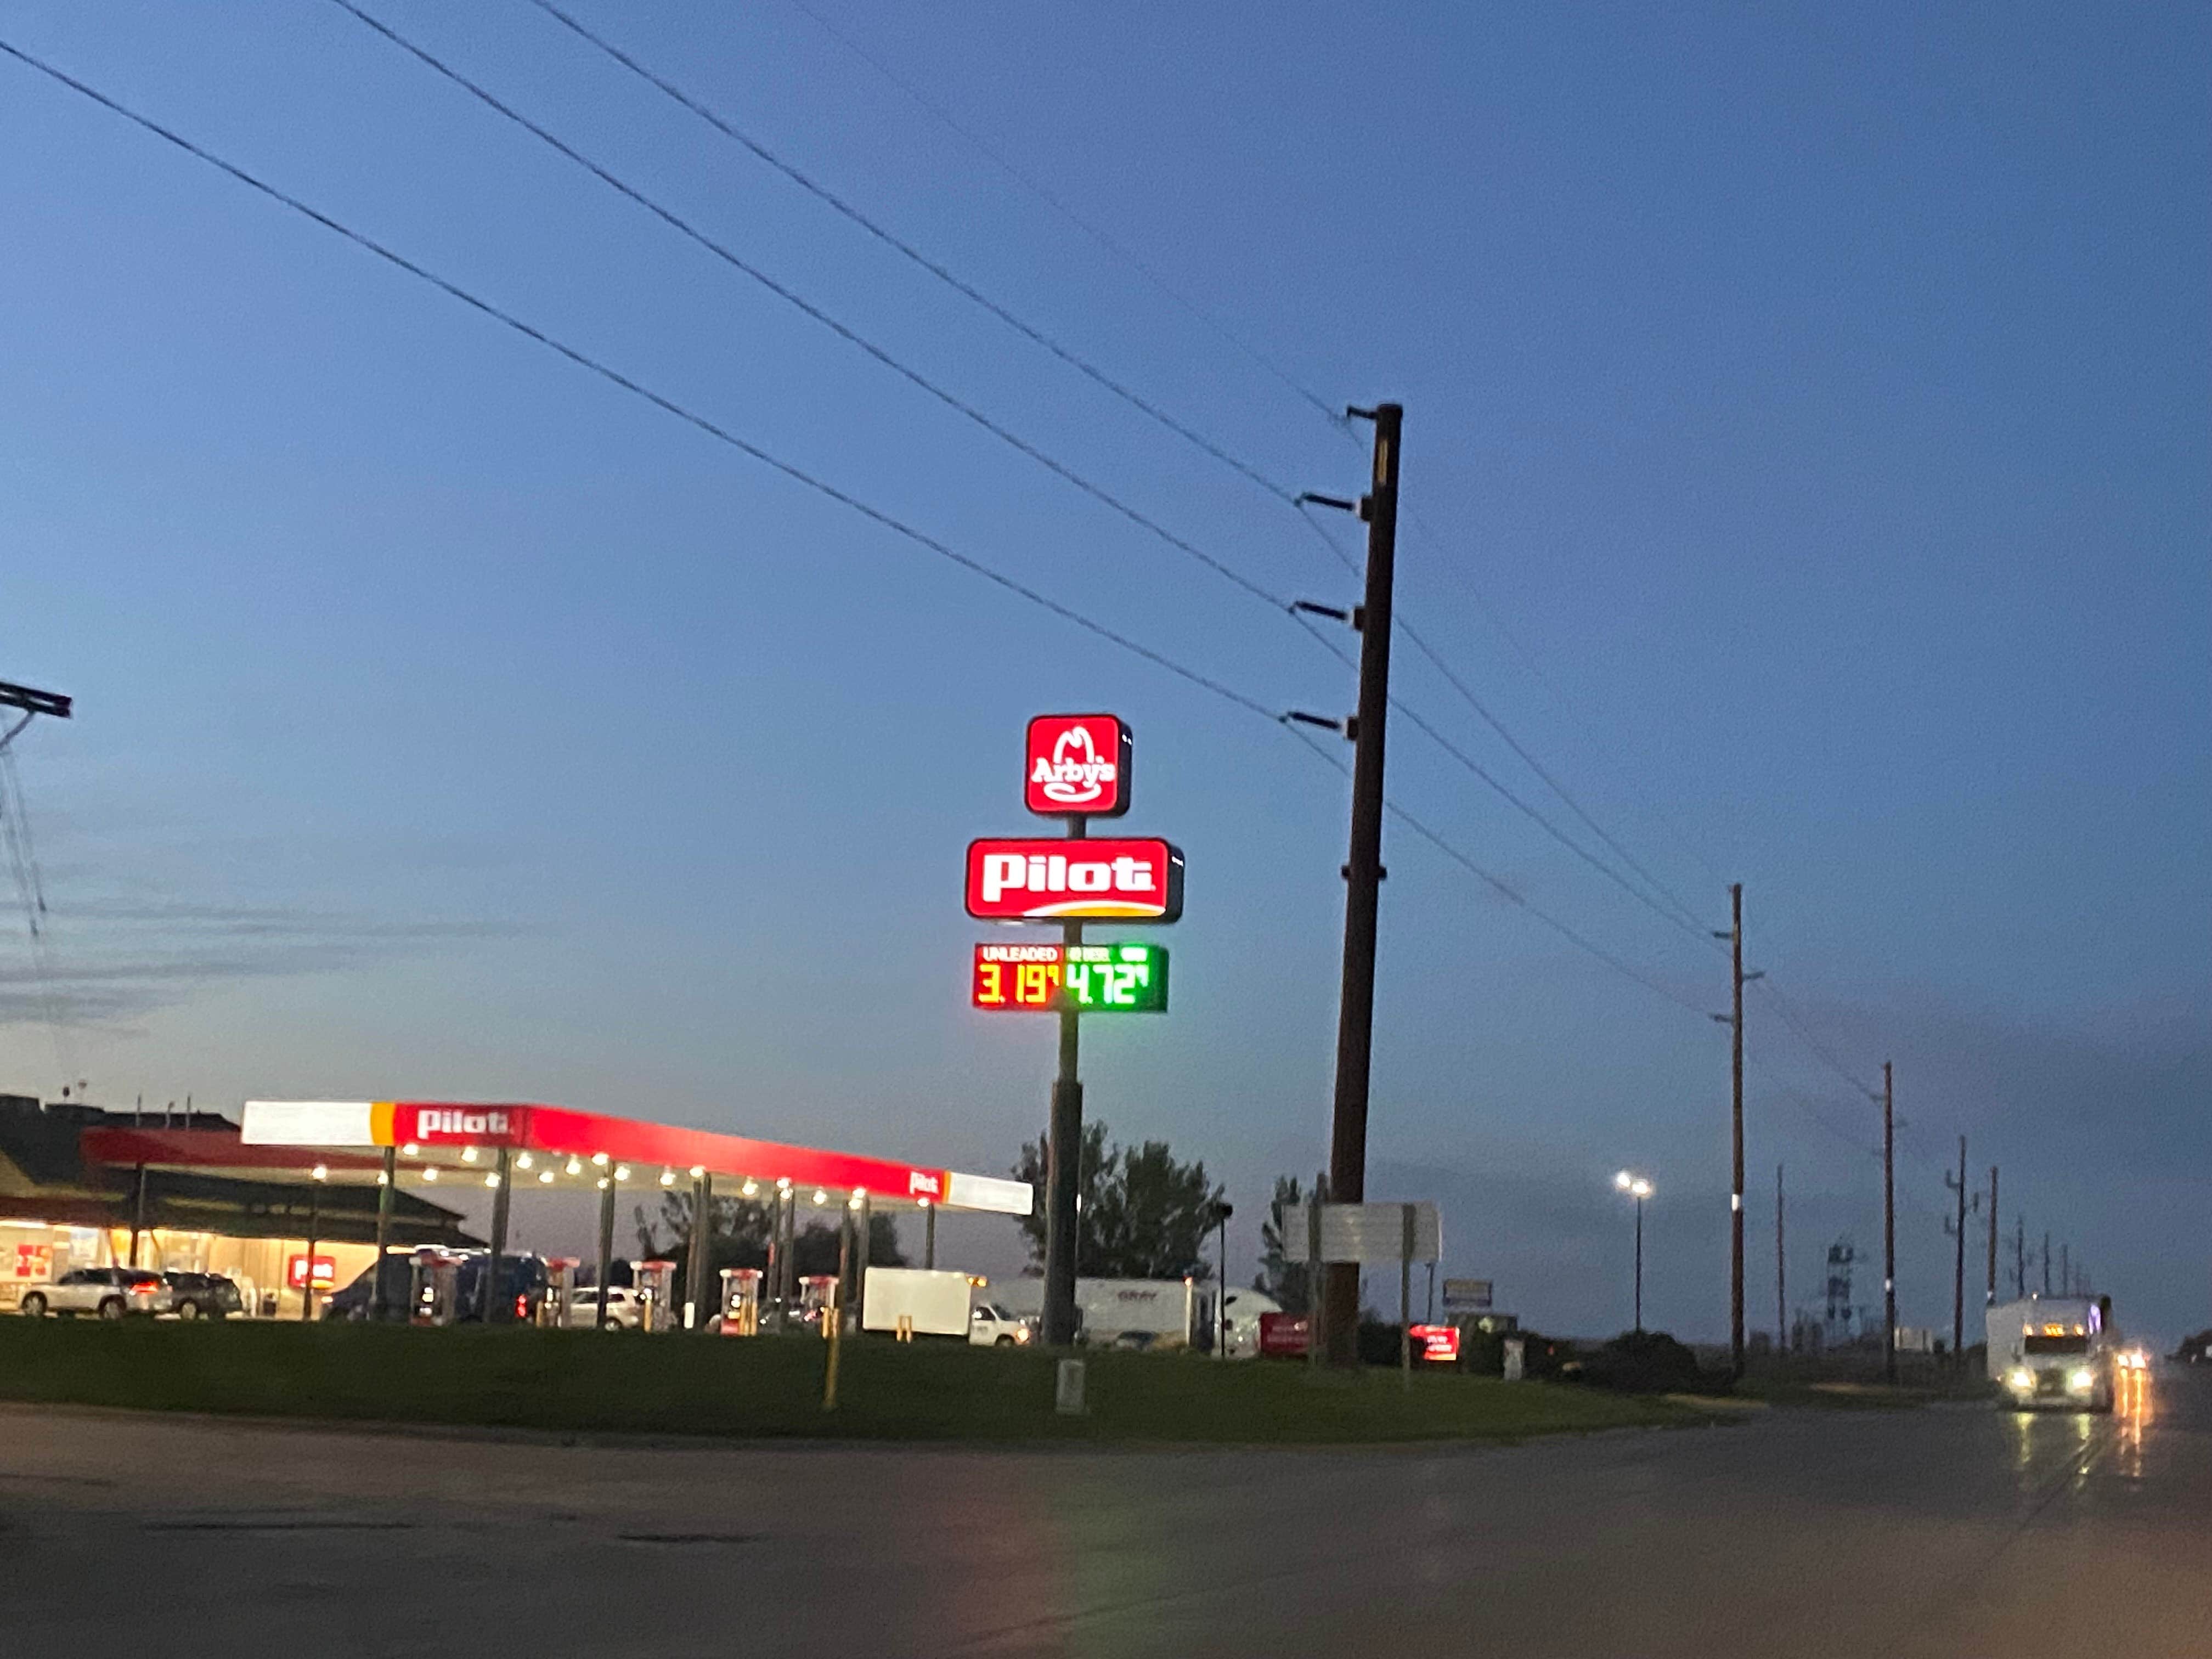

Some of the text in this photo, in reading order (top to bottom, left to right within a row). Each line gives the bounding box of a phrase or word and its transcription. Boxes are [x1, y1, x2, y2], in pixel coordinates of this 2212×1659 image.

[1031, 755, 1116, 788] Arby's
[983, 854, 1153, 902] Pilot
[983, 946, 1058, 962] UNLEADED
[417, 1109, 509, 1139] Pilot
